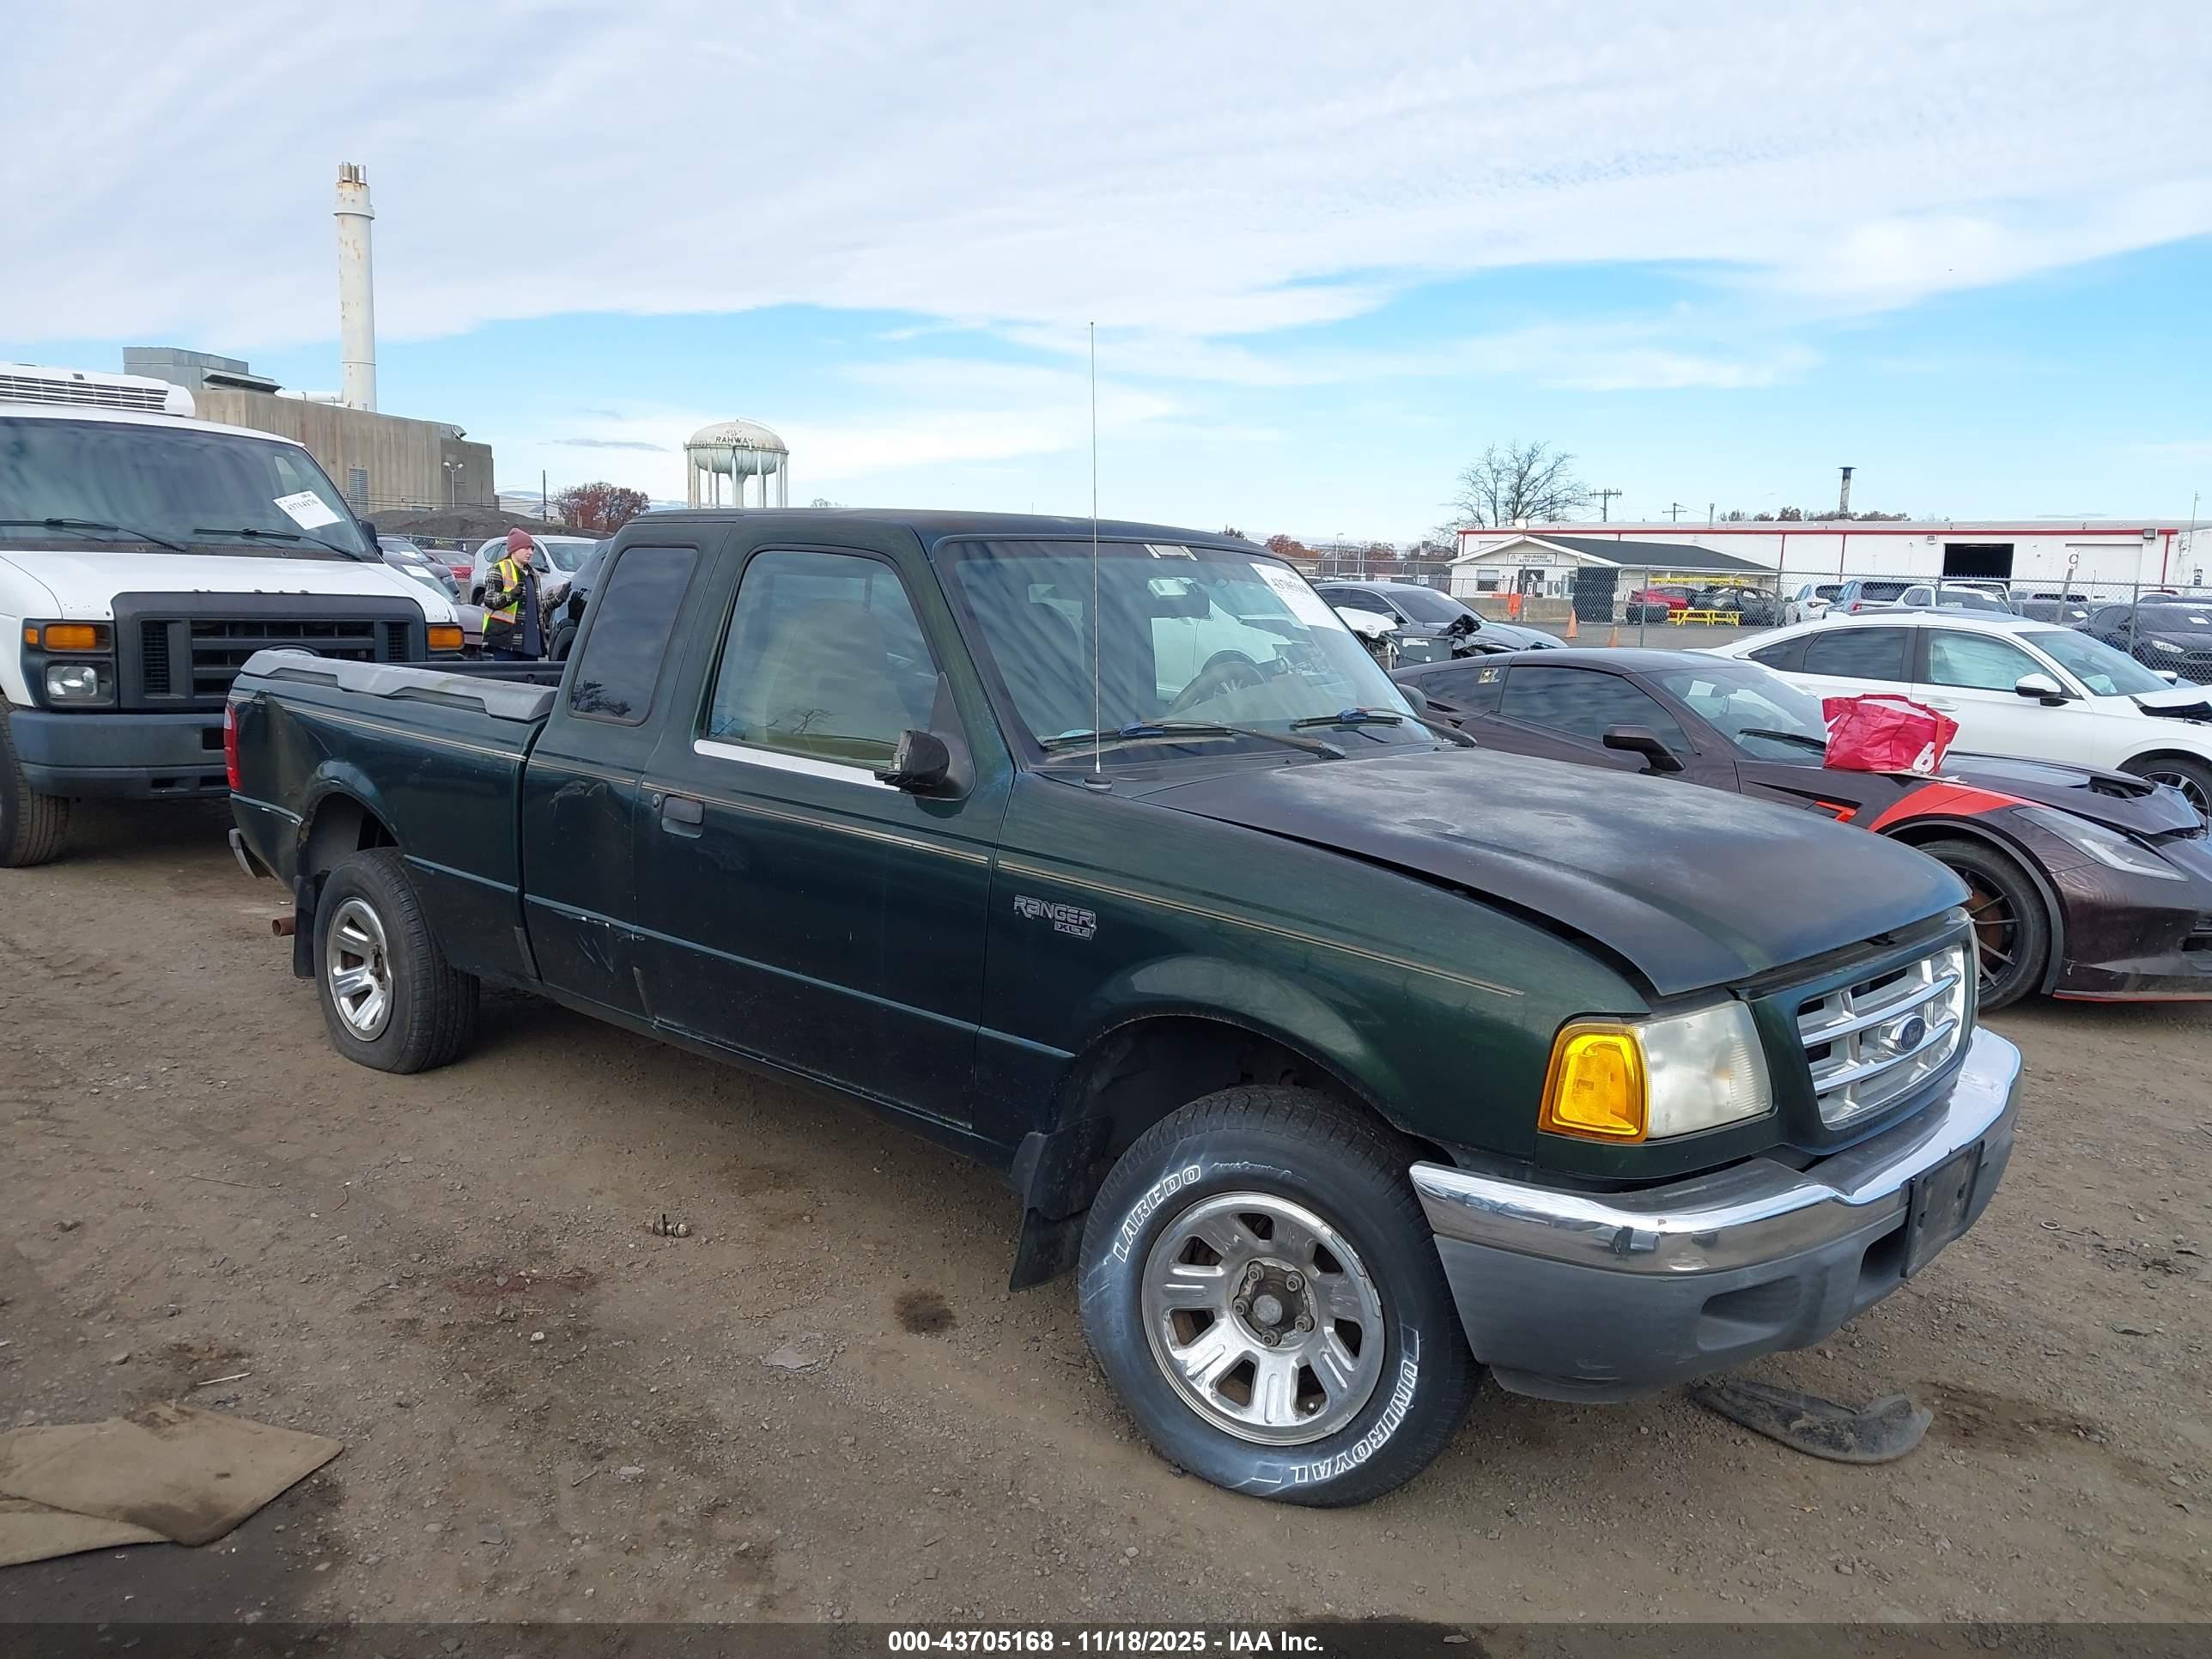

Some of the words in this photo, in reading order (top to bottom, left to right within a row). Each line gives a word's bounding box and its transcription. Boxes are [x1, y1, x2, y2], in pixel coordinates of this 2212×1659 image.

[1013, 895, 1096, 928] RANGER
[1056, 923, 1089, 937] XLT
[1112, 1164, 1201, 1264] LAREDO
[1290, 1359, 1419, 1484] UNIROYAL
